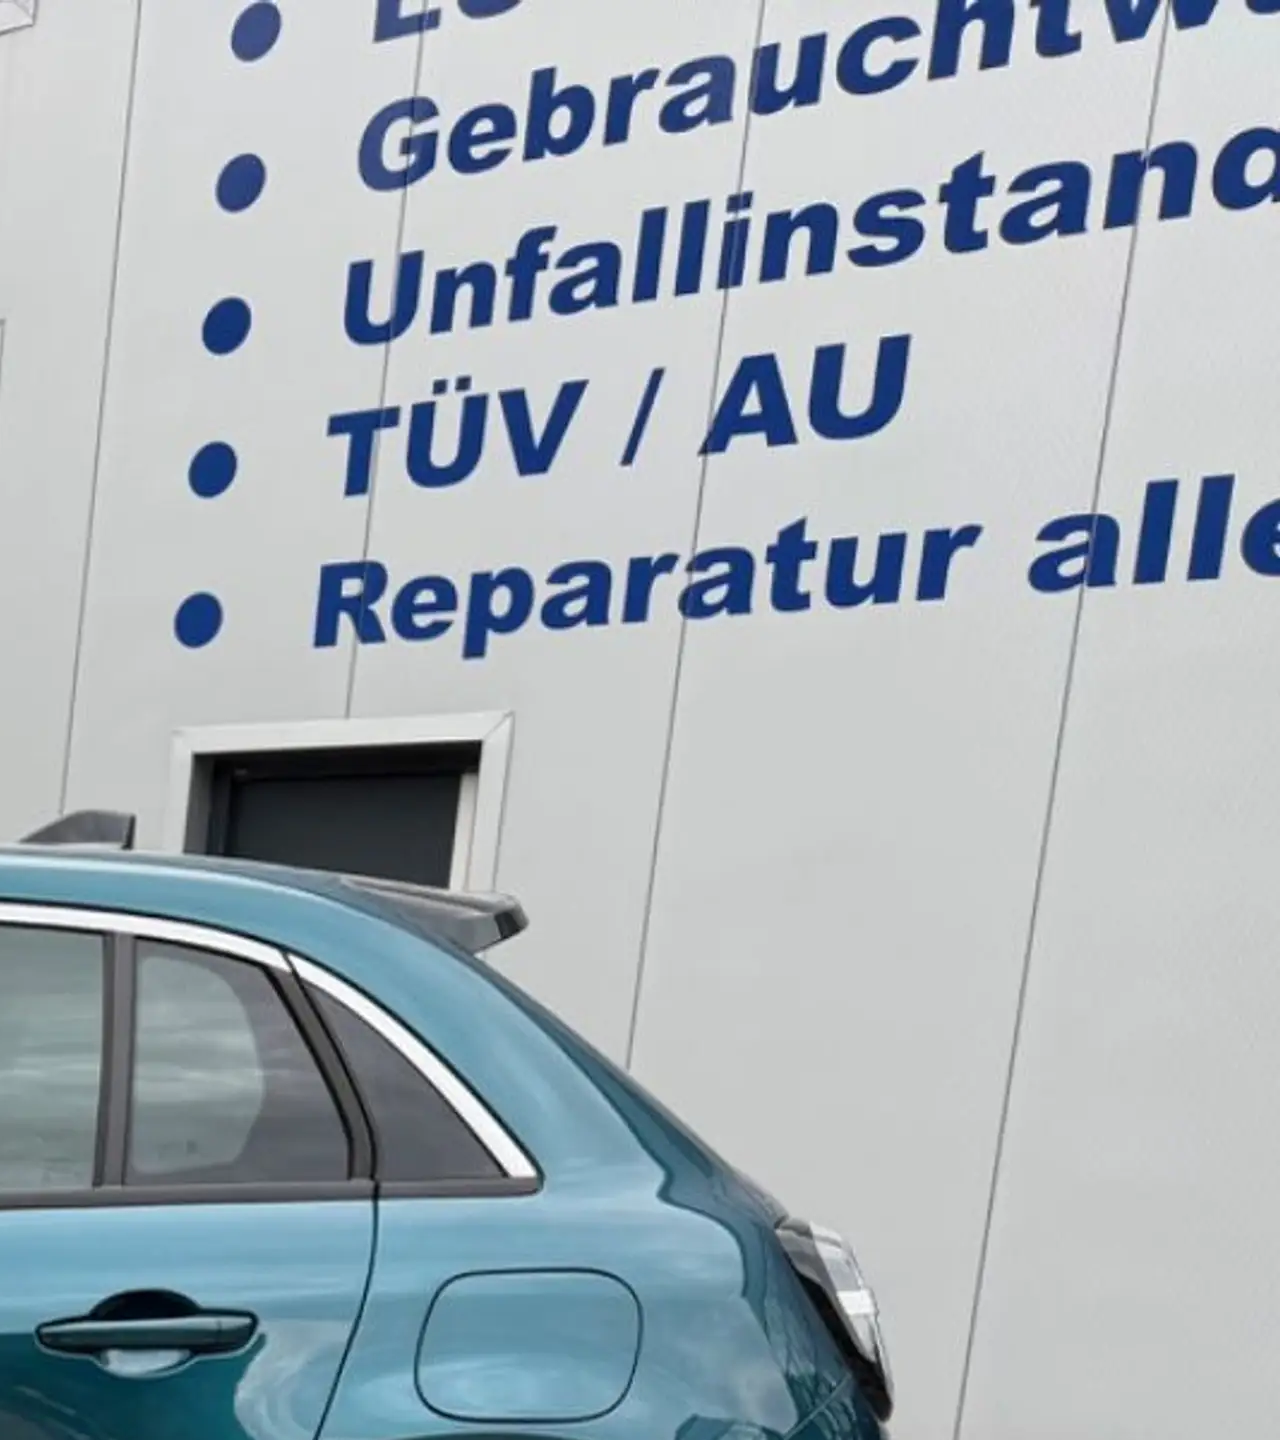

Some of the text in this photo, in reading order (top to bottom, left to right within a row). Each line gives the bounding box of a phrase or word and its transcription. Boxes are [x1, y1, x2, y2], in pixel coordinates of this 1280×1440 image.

[360, 0, 1280, 190] Gebrauchtw
[328, 335, 911, 496] TÜV / AU
[314, 520, 981, 659] Reparatur
